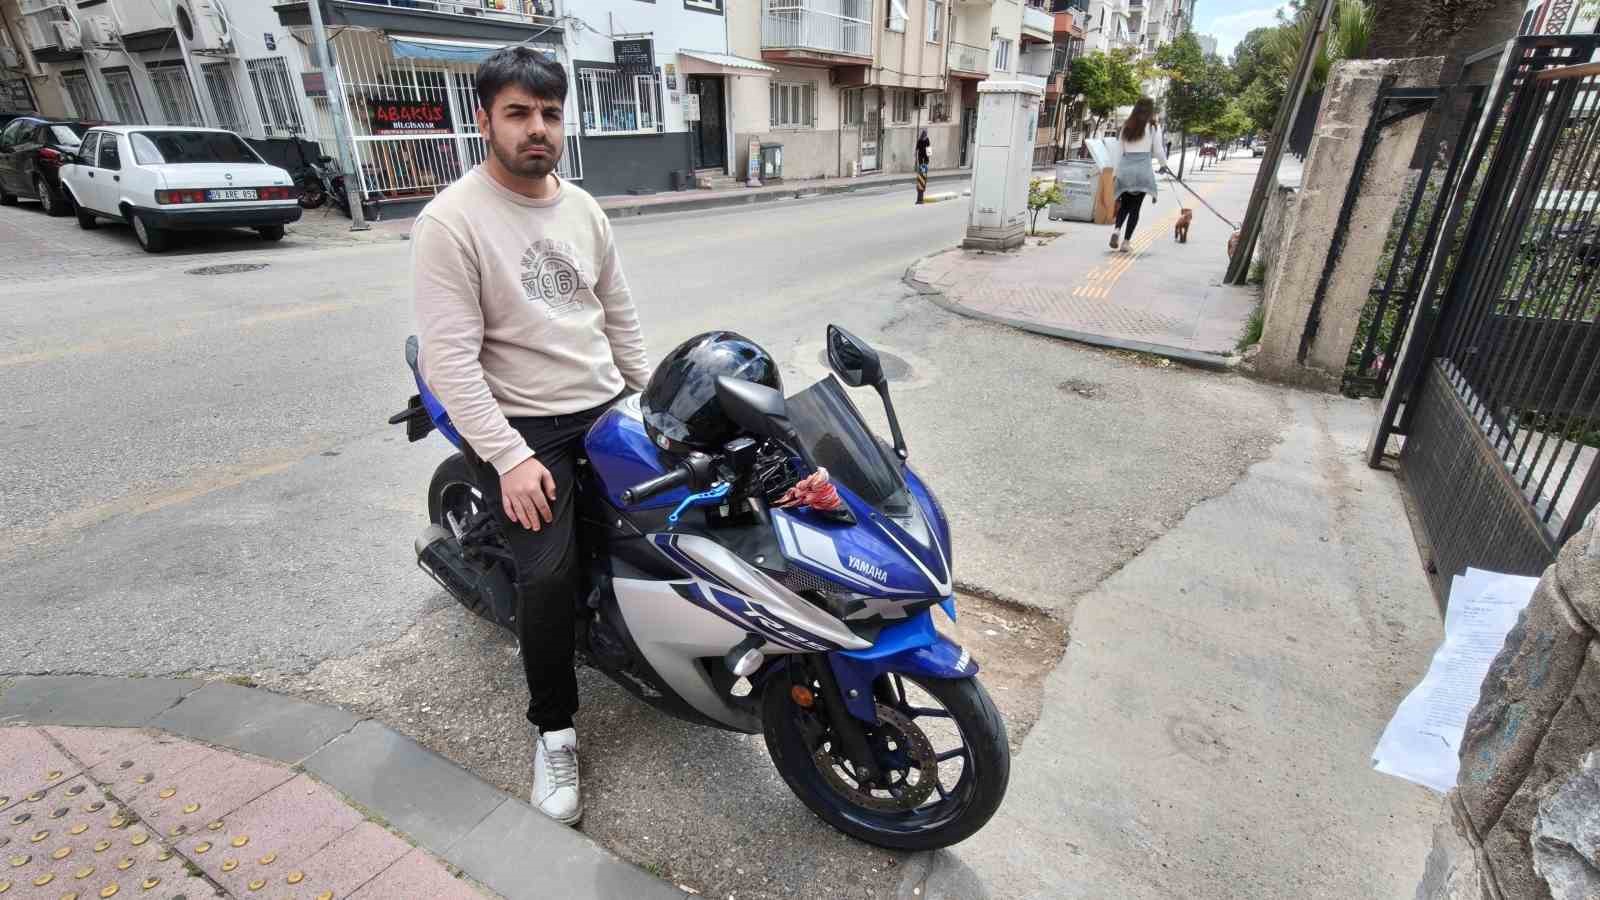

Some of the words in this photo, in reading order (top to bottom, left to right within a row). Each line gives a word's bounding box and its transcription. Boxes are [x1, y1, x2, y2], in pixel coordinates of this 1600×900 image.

[376, 104, 443, 121] ABAKÜS
[542, 270, 573, 298] 96
[848, 555, 888, 583] YAMAHA
